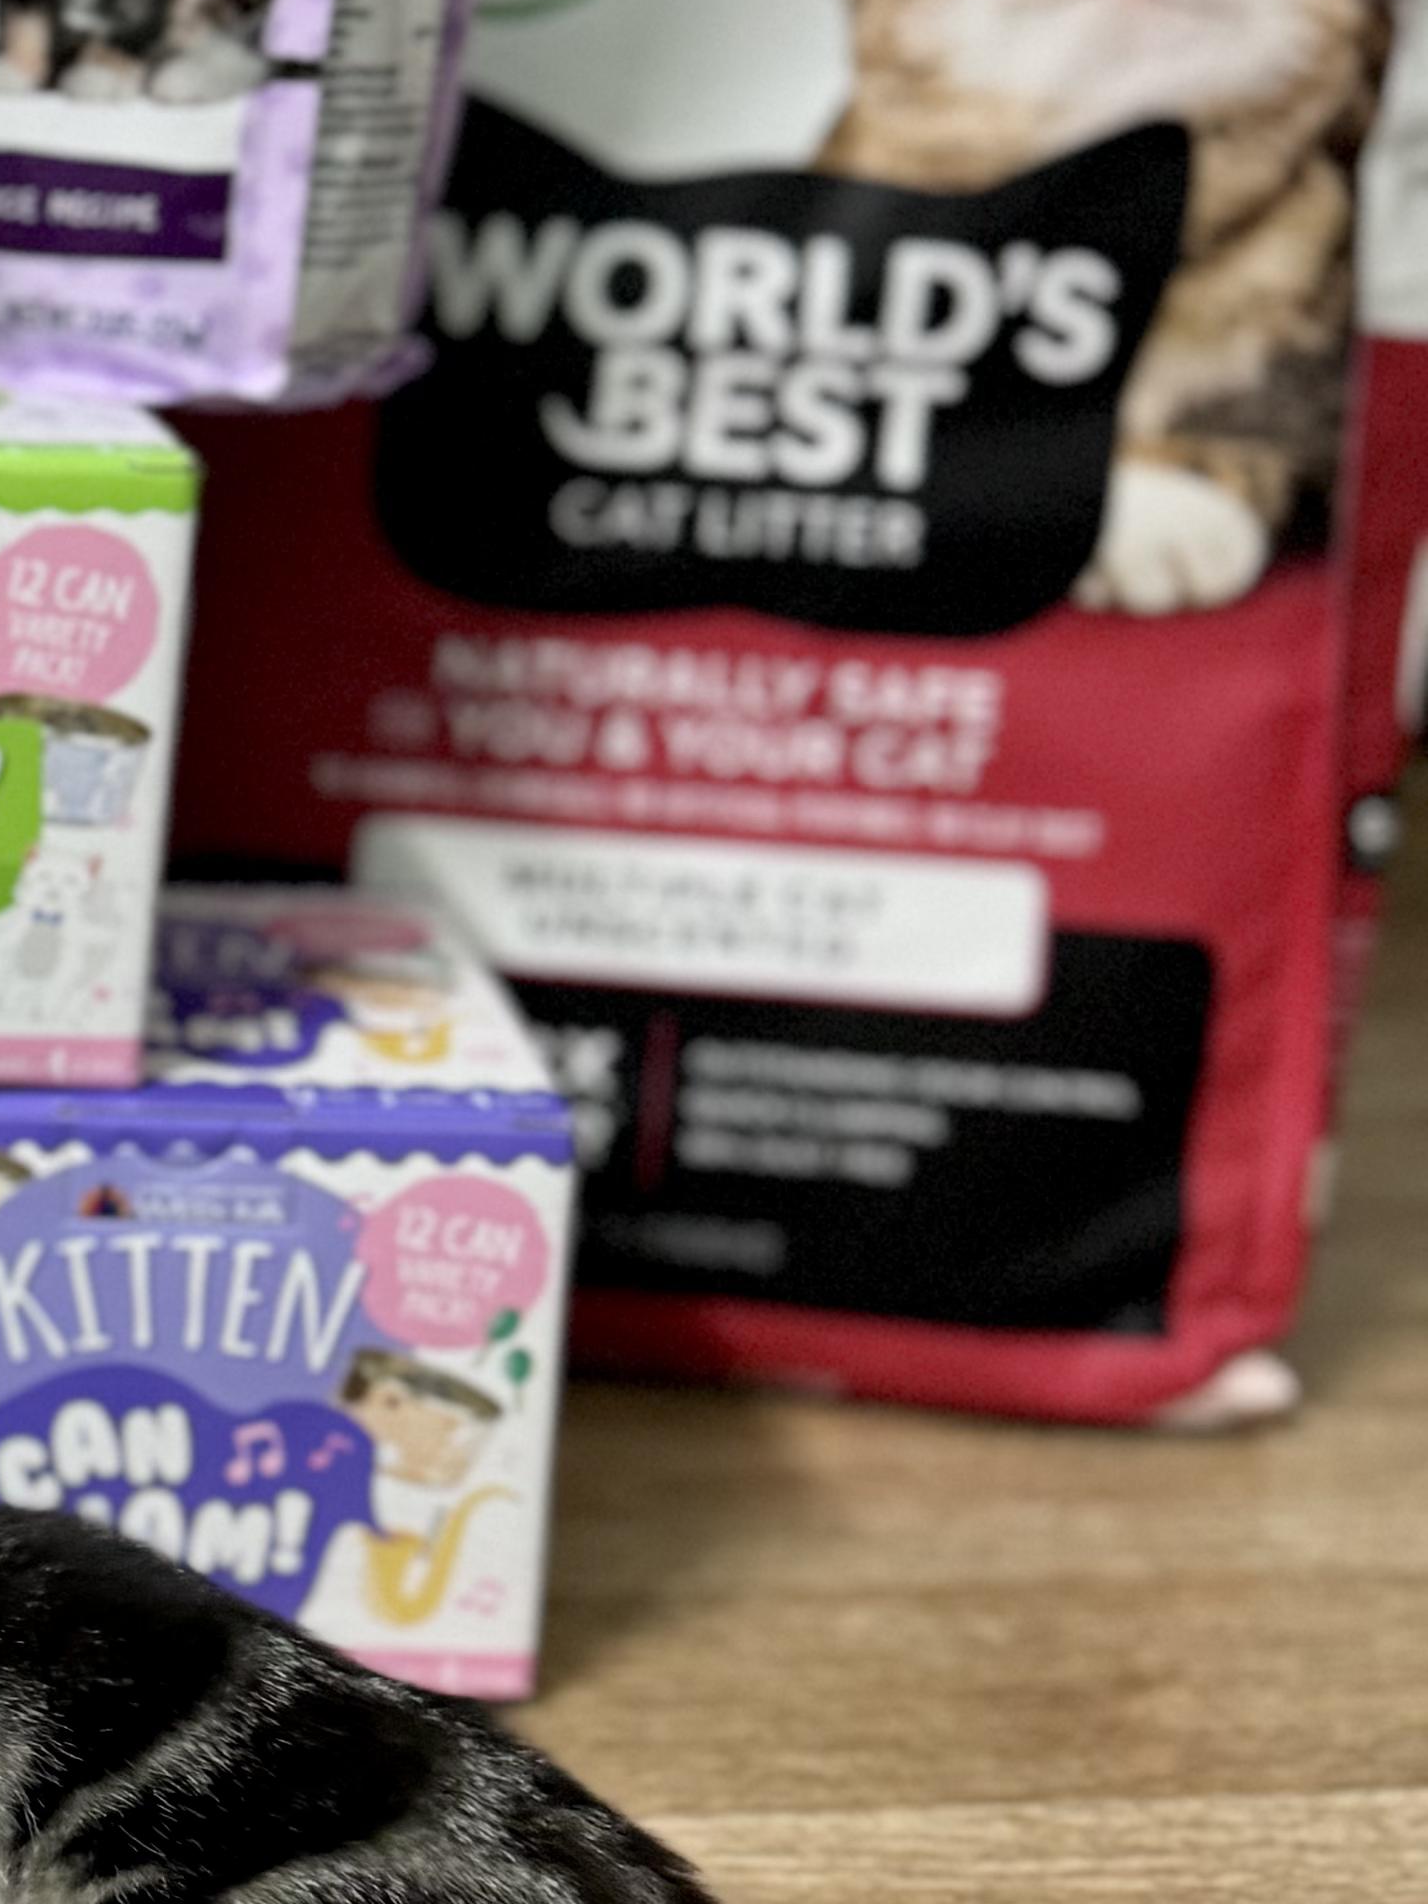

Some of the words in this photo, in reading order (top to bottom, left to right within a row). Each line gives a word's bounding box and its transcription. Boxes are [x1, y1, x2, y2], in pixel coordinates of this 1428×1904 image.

[424, 205, 1121, 387] WORLD'S
[539, 346, 969, 493] BEST
[546, 480, 693, 549] CAT
[696, 486, 928, 570] LITTER
[7, 555, 48, 607] 12
[53, 564, 135, 625] CAN
[432, 632, 824, 713] NATURALLY
[828, 657, 1005, 726] SAFE
[660, 710, 846, 785] YOUR
[851, 720, 991, 795] CAT
[443, 1213, 524, 1269] CAN
[77, 1488, 314, 1585] AM!
